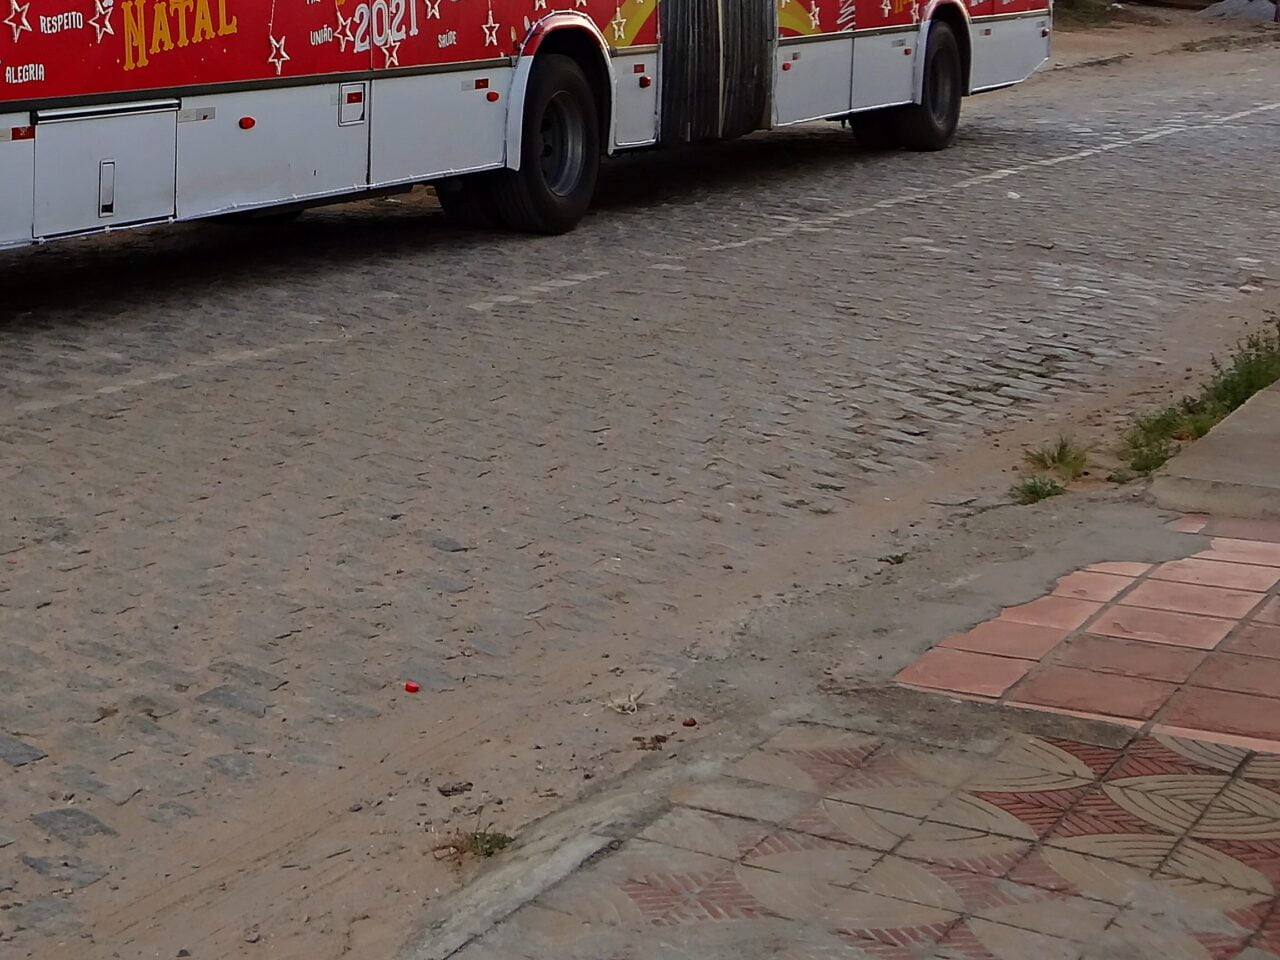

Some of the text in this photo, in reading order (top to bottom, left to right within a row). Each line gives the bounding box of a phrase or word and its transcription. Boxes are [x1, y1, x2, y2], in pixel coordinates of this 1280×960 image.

[39, 11, 83, 34] RESPEITO
[310, 24, 333, 46] UNIÃO
[437, 29, 457, 48] SAÚDE
[6, 63, 45, 84] ALEGRIA
